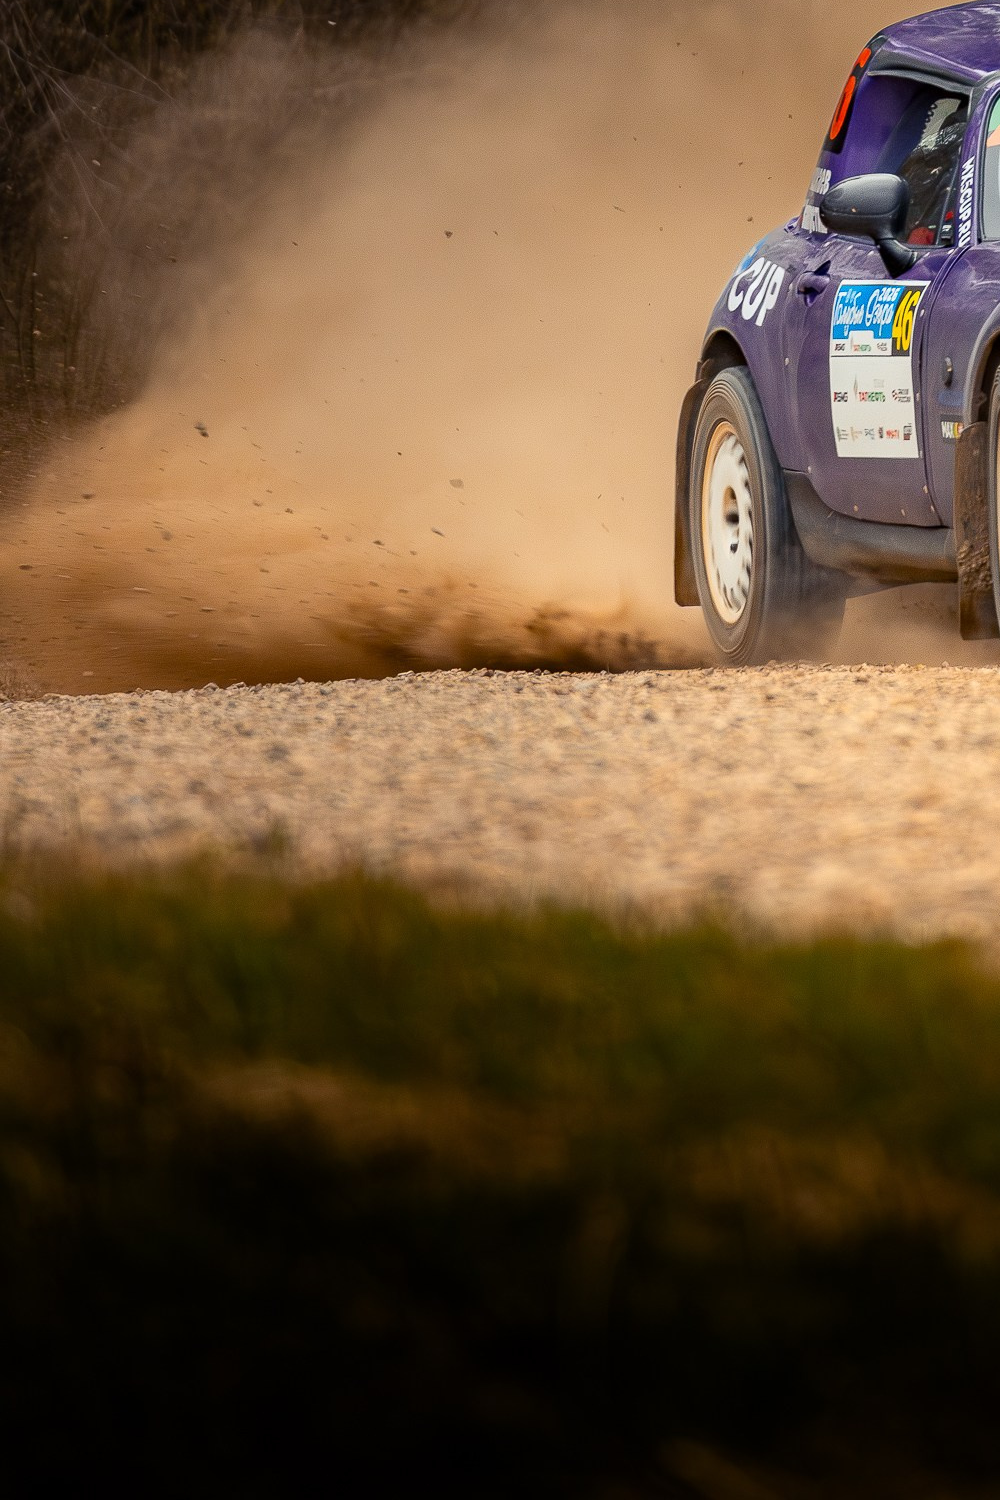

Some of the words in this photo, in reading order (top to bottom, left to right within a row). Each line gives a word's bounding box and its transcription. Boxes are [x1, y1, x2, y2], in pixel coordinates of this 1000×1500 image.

[957, 155, 976, 248] MX5CUP.RU
[727, 256, 786, 327] CUP
[891, 290, 921, 351] 46
